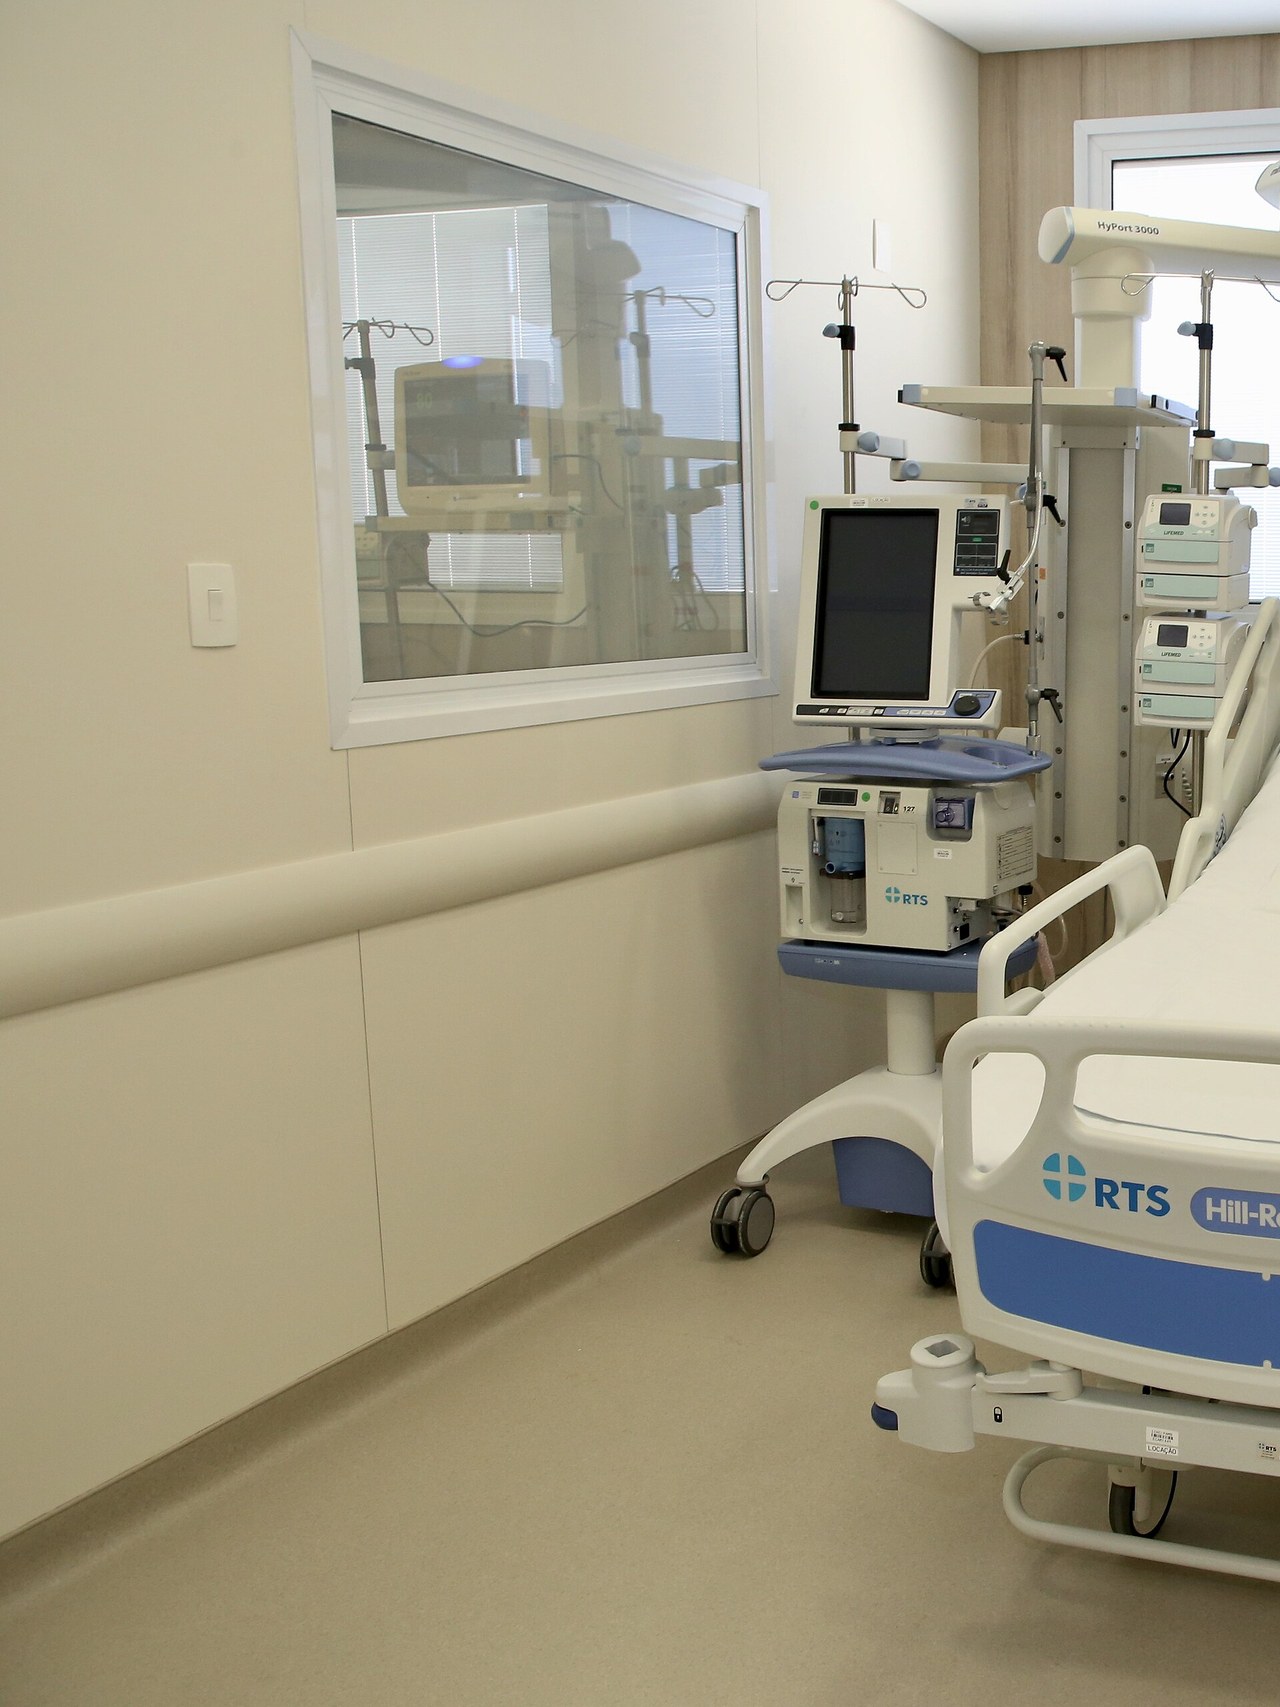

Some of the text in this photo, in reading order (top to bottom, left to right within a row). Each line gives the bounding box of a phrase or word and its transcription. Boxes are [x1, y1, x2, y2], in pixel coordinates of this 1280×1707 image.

[1097, 221, 1160, 235] HyPort 3000
[902, 893, 928, 906] RTS
[1094, 1176, 1172, 1217] RTS
